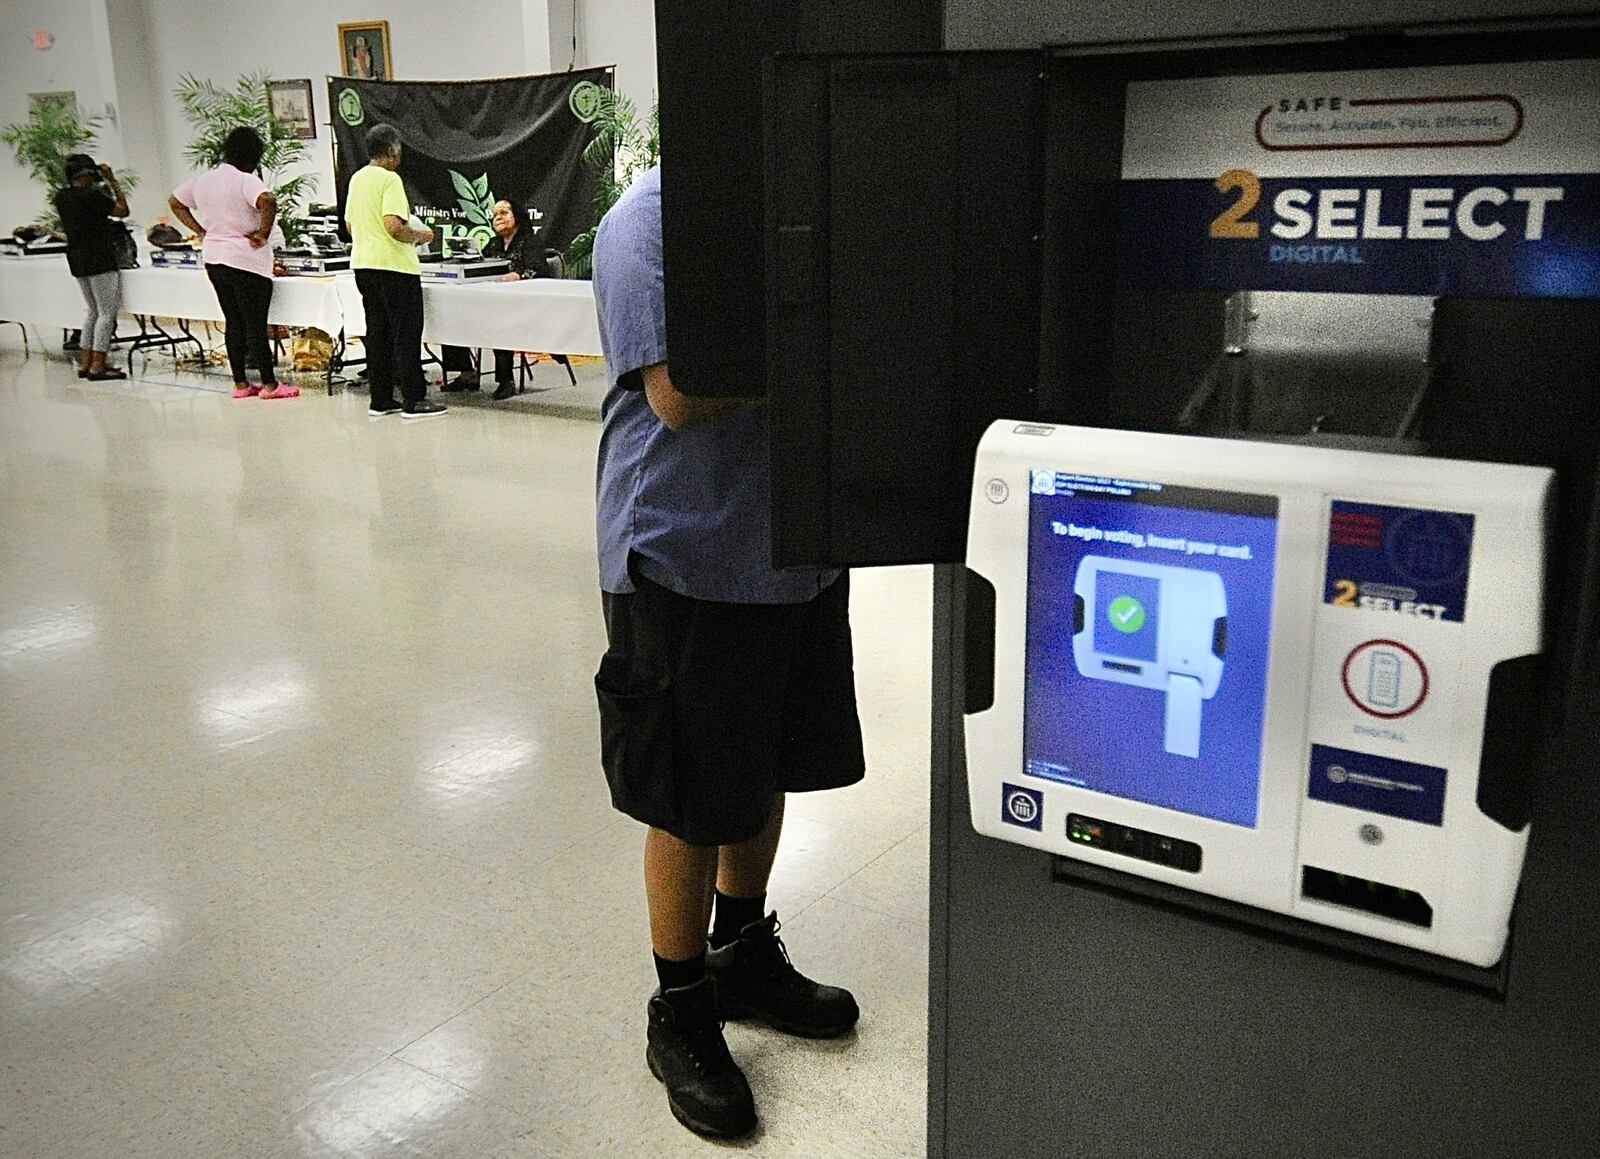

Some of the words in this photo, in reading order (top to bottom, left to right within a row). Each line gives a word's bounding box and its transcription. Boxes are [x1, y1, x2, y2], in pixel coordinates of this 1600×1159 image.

[1278, 97, 1342, 112] SAFE
[414, 205, 451, 221] Ministry
[1208, 168, 1262, 239] 2
[1270, 186, 1565, 241] SELECT
[1269, 245, 1364, 265] DIGITAL
[1052, 521, 1067, 535] To
[1068, 523, 1103, 541] begin
[1103, 530, 1147, 548] voting,
[1147, 533, 1186, 551] insert
[1186, 541, 1217, 555] your
[1217, 545, 1253, 560] card.
[1333, 579, 1357, 608] 2
